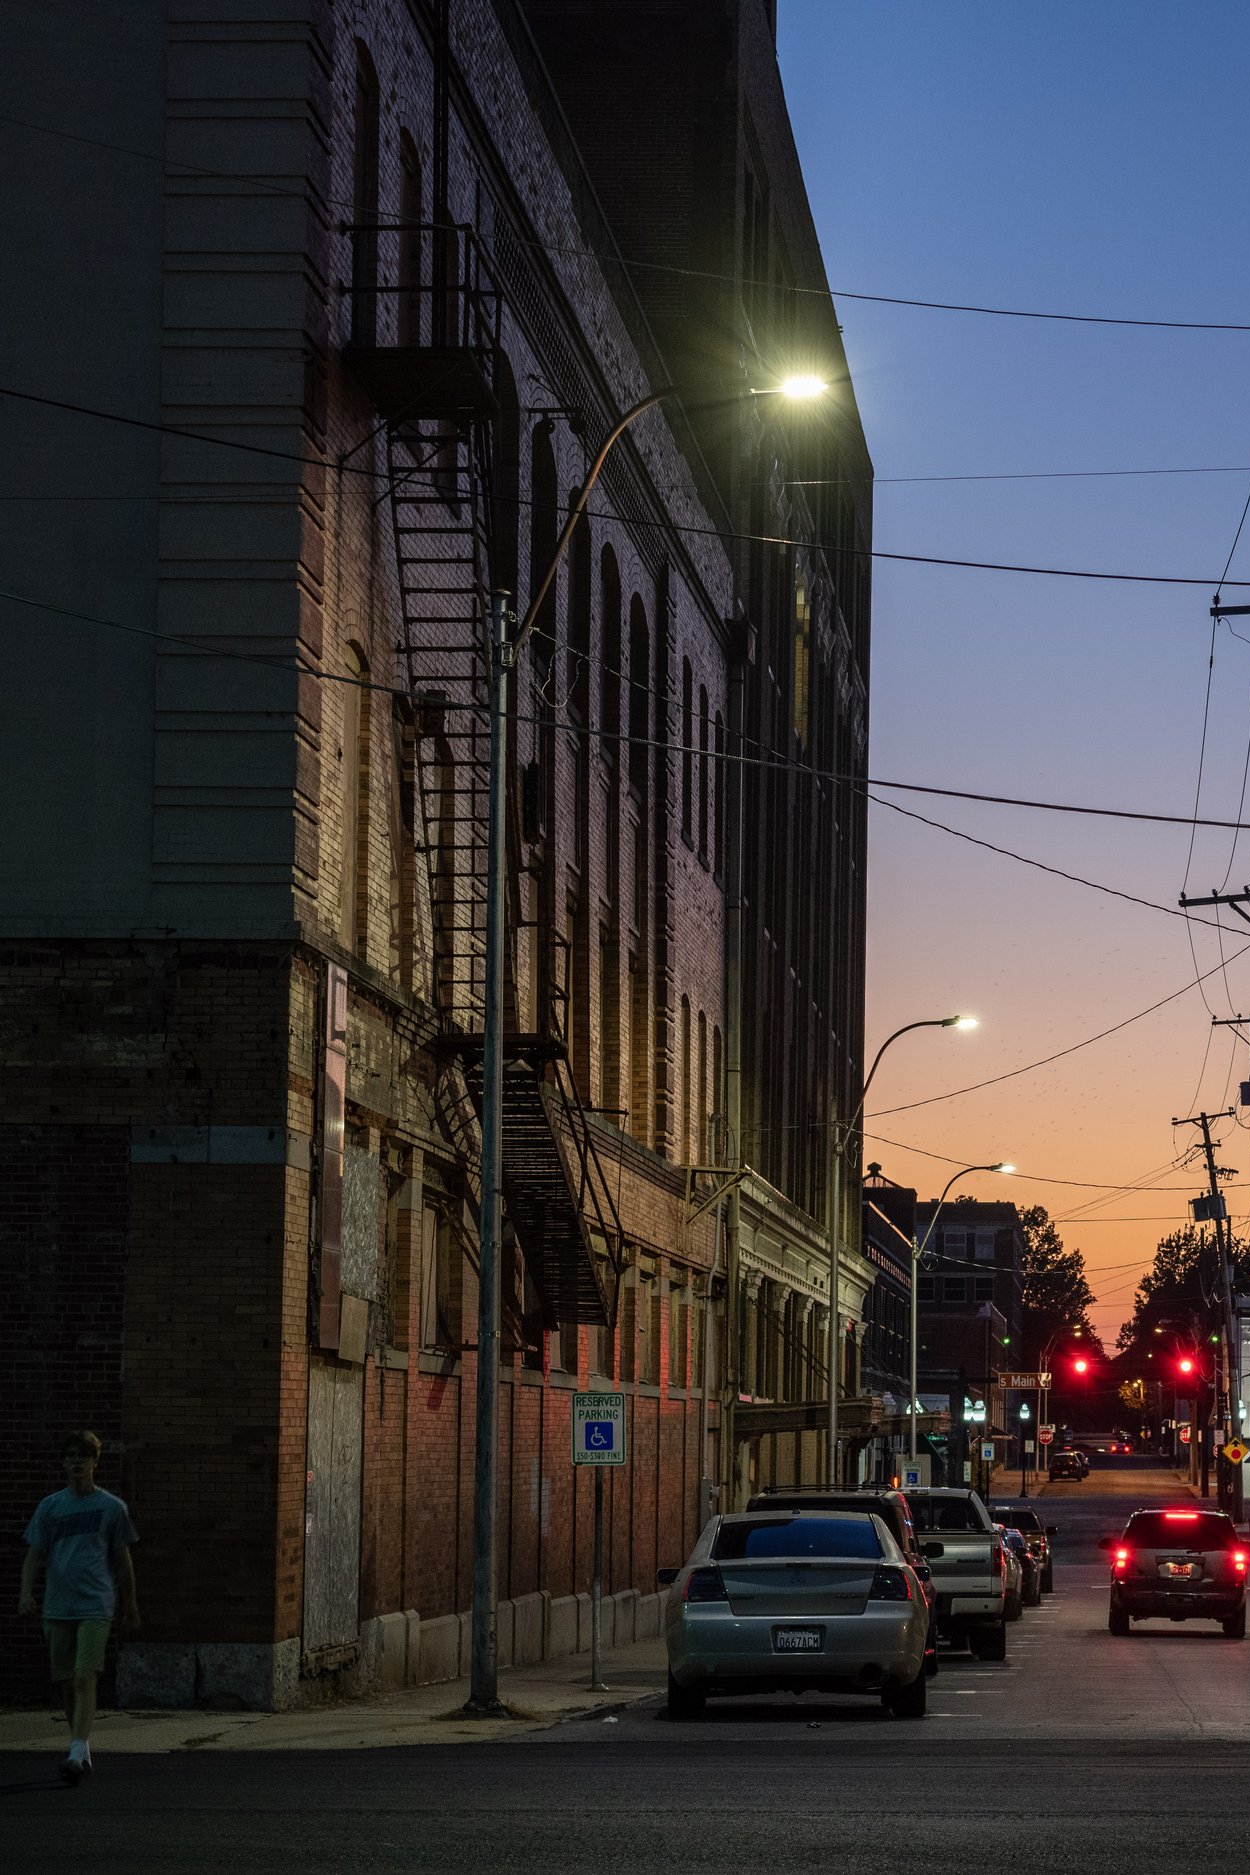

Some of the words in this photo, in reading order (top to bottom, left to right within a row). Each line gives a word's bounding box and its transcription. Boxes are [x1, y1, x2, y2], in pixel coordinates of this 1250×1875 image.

[1011, 1375, 1036, 1387] Main
[576, 1396, 621, 1407] RESERVED
[578, 1410, 619, 1420] PARKING
[607, 1451, 621, 1460] FINE
